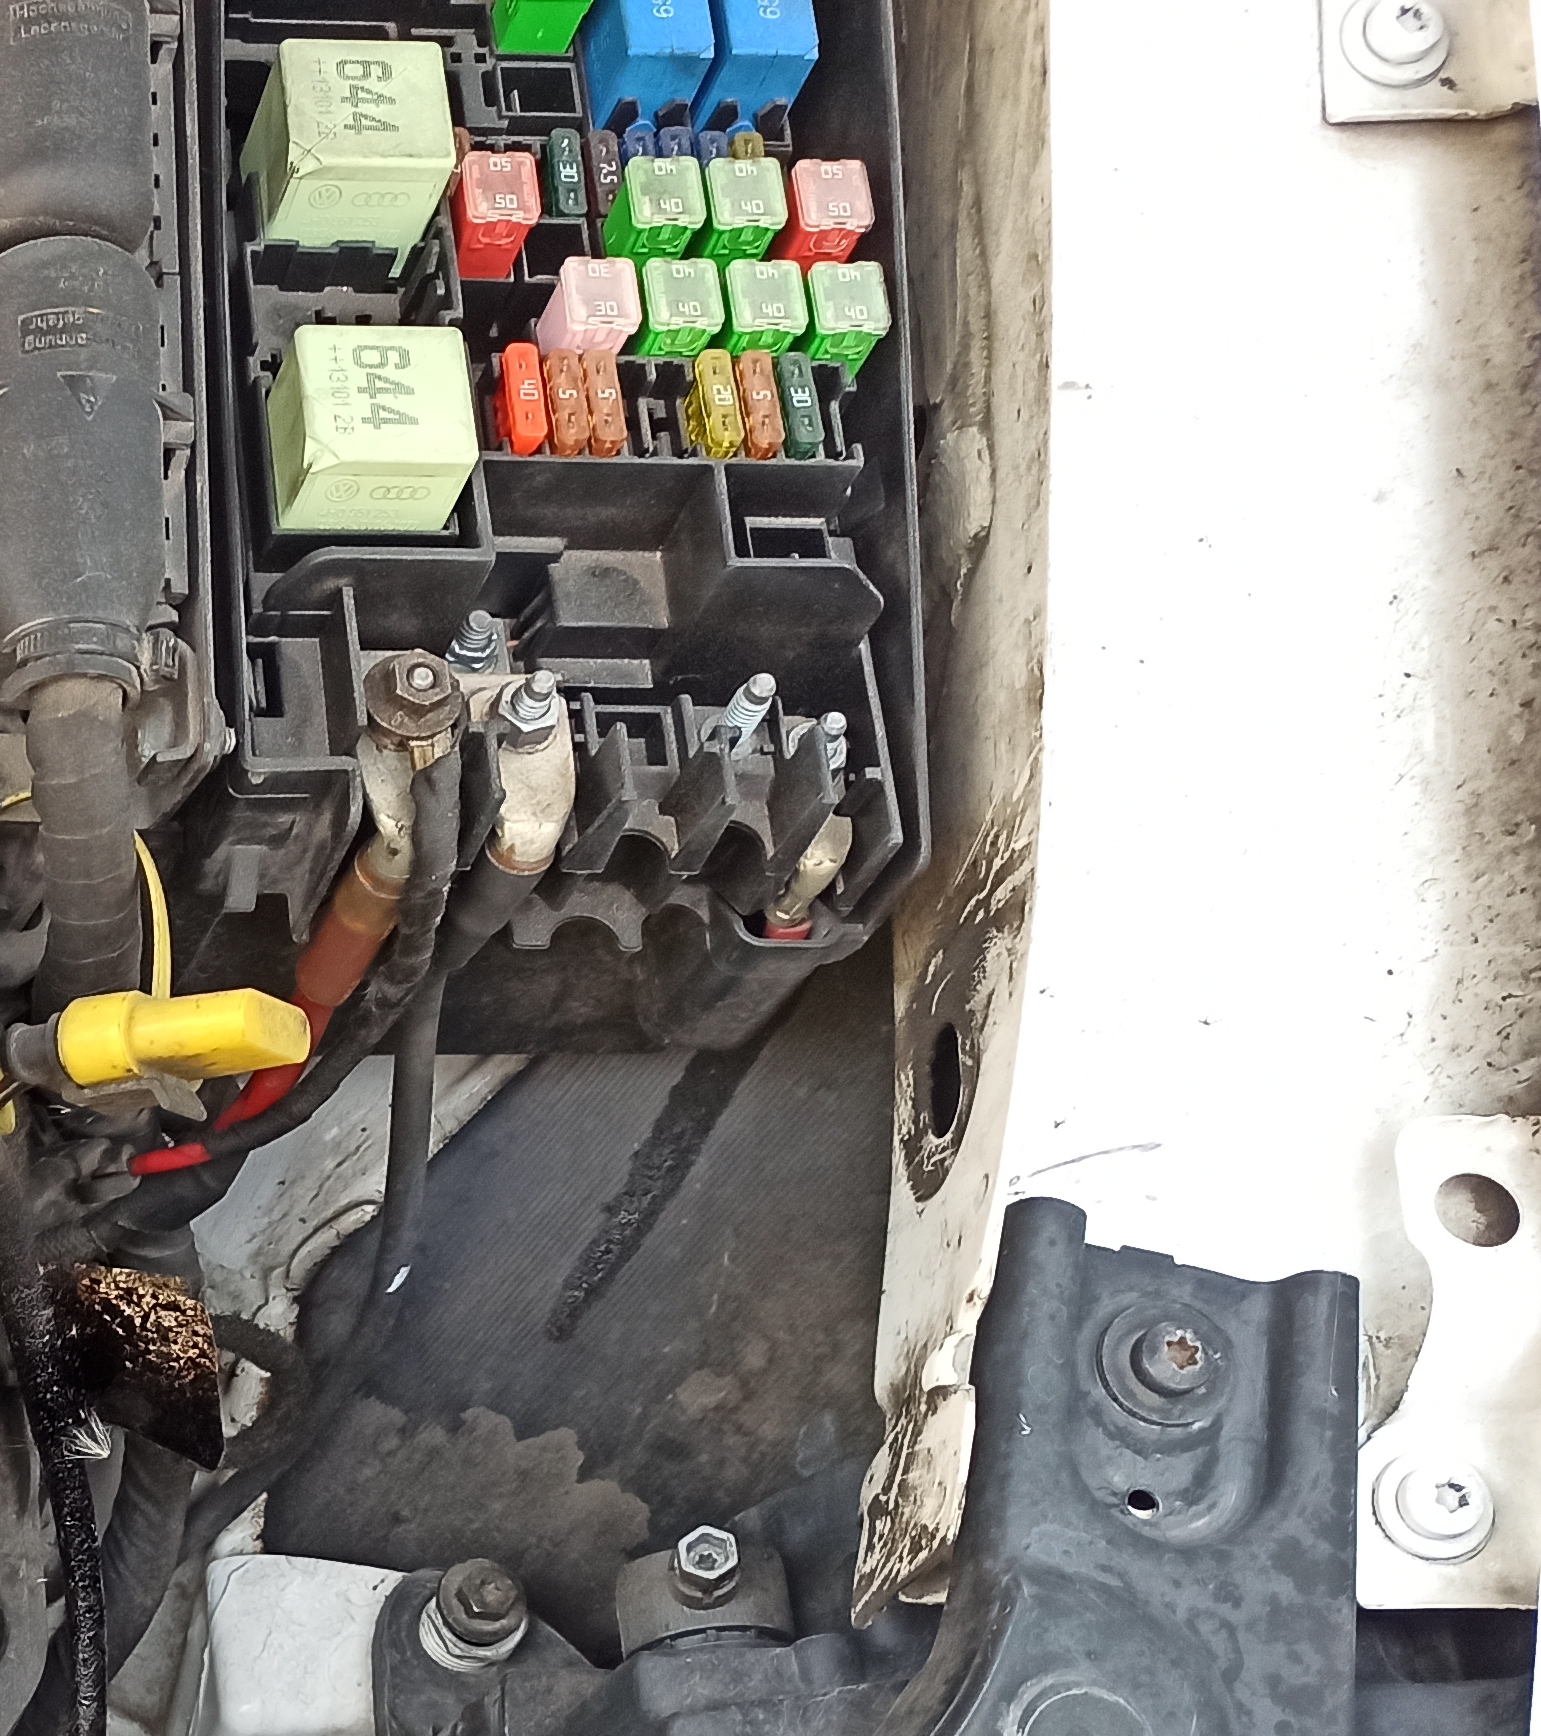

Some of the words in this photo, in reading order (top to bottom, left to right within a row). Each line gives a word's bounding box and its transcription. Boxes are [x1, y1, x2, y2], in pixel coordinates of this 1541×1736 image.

[336, 58, 399, 135] 644
[560, 162, 578, 183] 30
[599, 160, 618, 184] 7.5
[494, 194, 517, 208] 50
[660, 198, 683, 213] 40
[741, 199, 764, 214] 40
[828, 202, 851, 216] 50
[595, 301, 618, 315] 30
[678, 301, 701, 316] 40
[761, 302, 785, 317] 40
[844, 305, 868, 320] 40
[352, 344, 419, 430] 644
[519, 379, 539, 400] 40
[558, 388, 577, 399] 5
[597, 388, 616, 400] 5
[712, 384, 734, 406] 20
[752, 389, 772, 401] 5
[790, 386, 812, 407] 30
